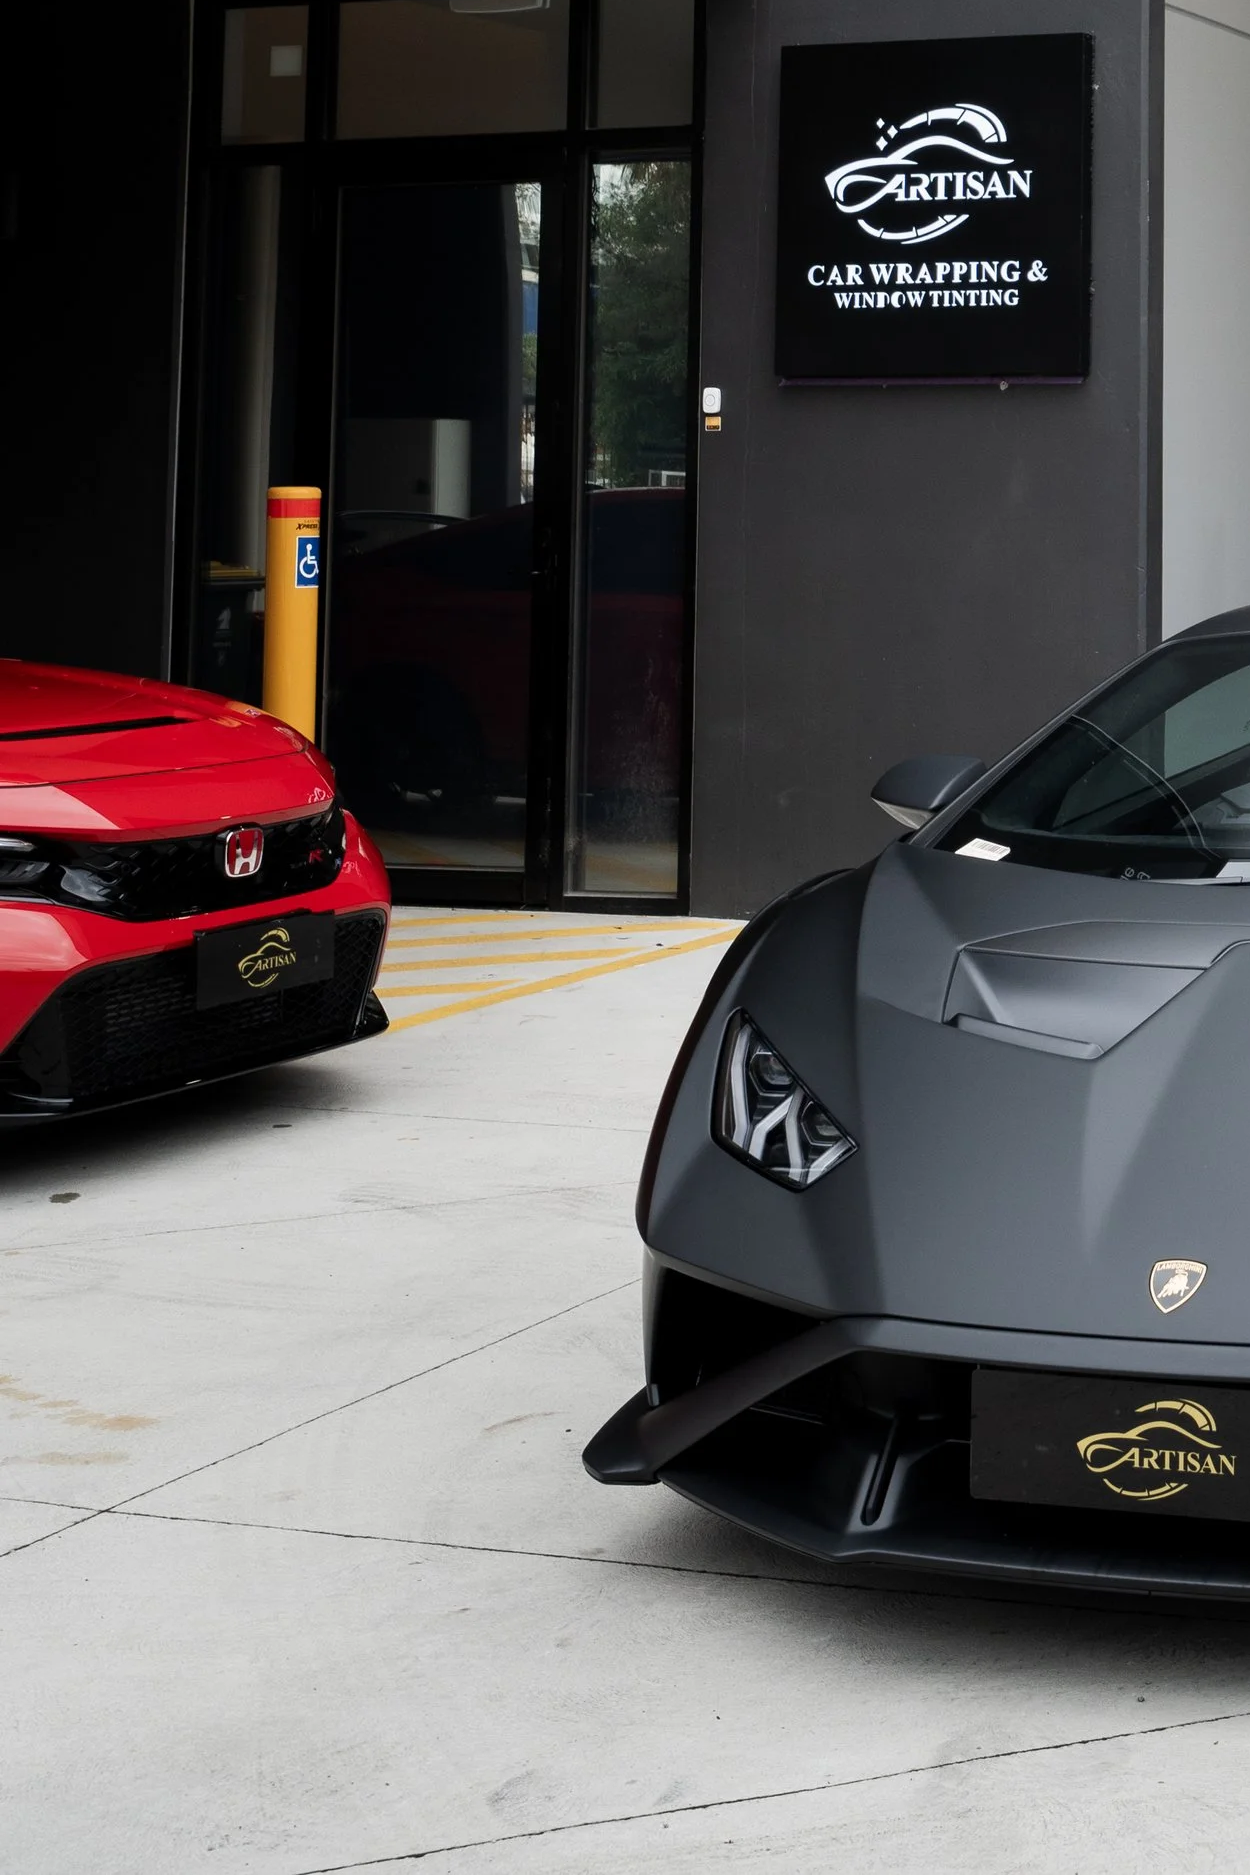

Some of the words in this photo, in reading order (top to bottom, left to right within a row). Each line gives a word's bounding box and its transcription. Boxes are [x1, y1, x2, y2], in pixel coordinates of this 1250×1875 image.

[885, 169, 1033, 202] ARTISAN
[807, 265, 863, 287] CAR
[869, 260, 1021, 286] WRAPPING
[1027, 260, 1049, 282] &
[833, 291, 926, 309] WINDOW
[928, 288, 1020, 308] TINTING
[255, 951, 297, 972] ARTISAN
[1122, 1447, 1237, 1476] ARTISAN
